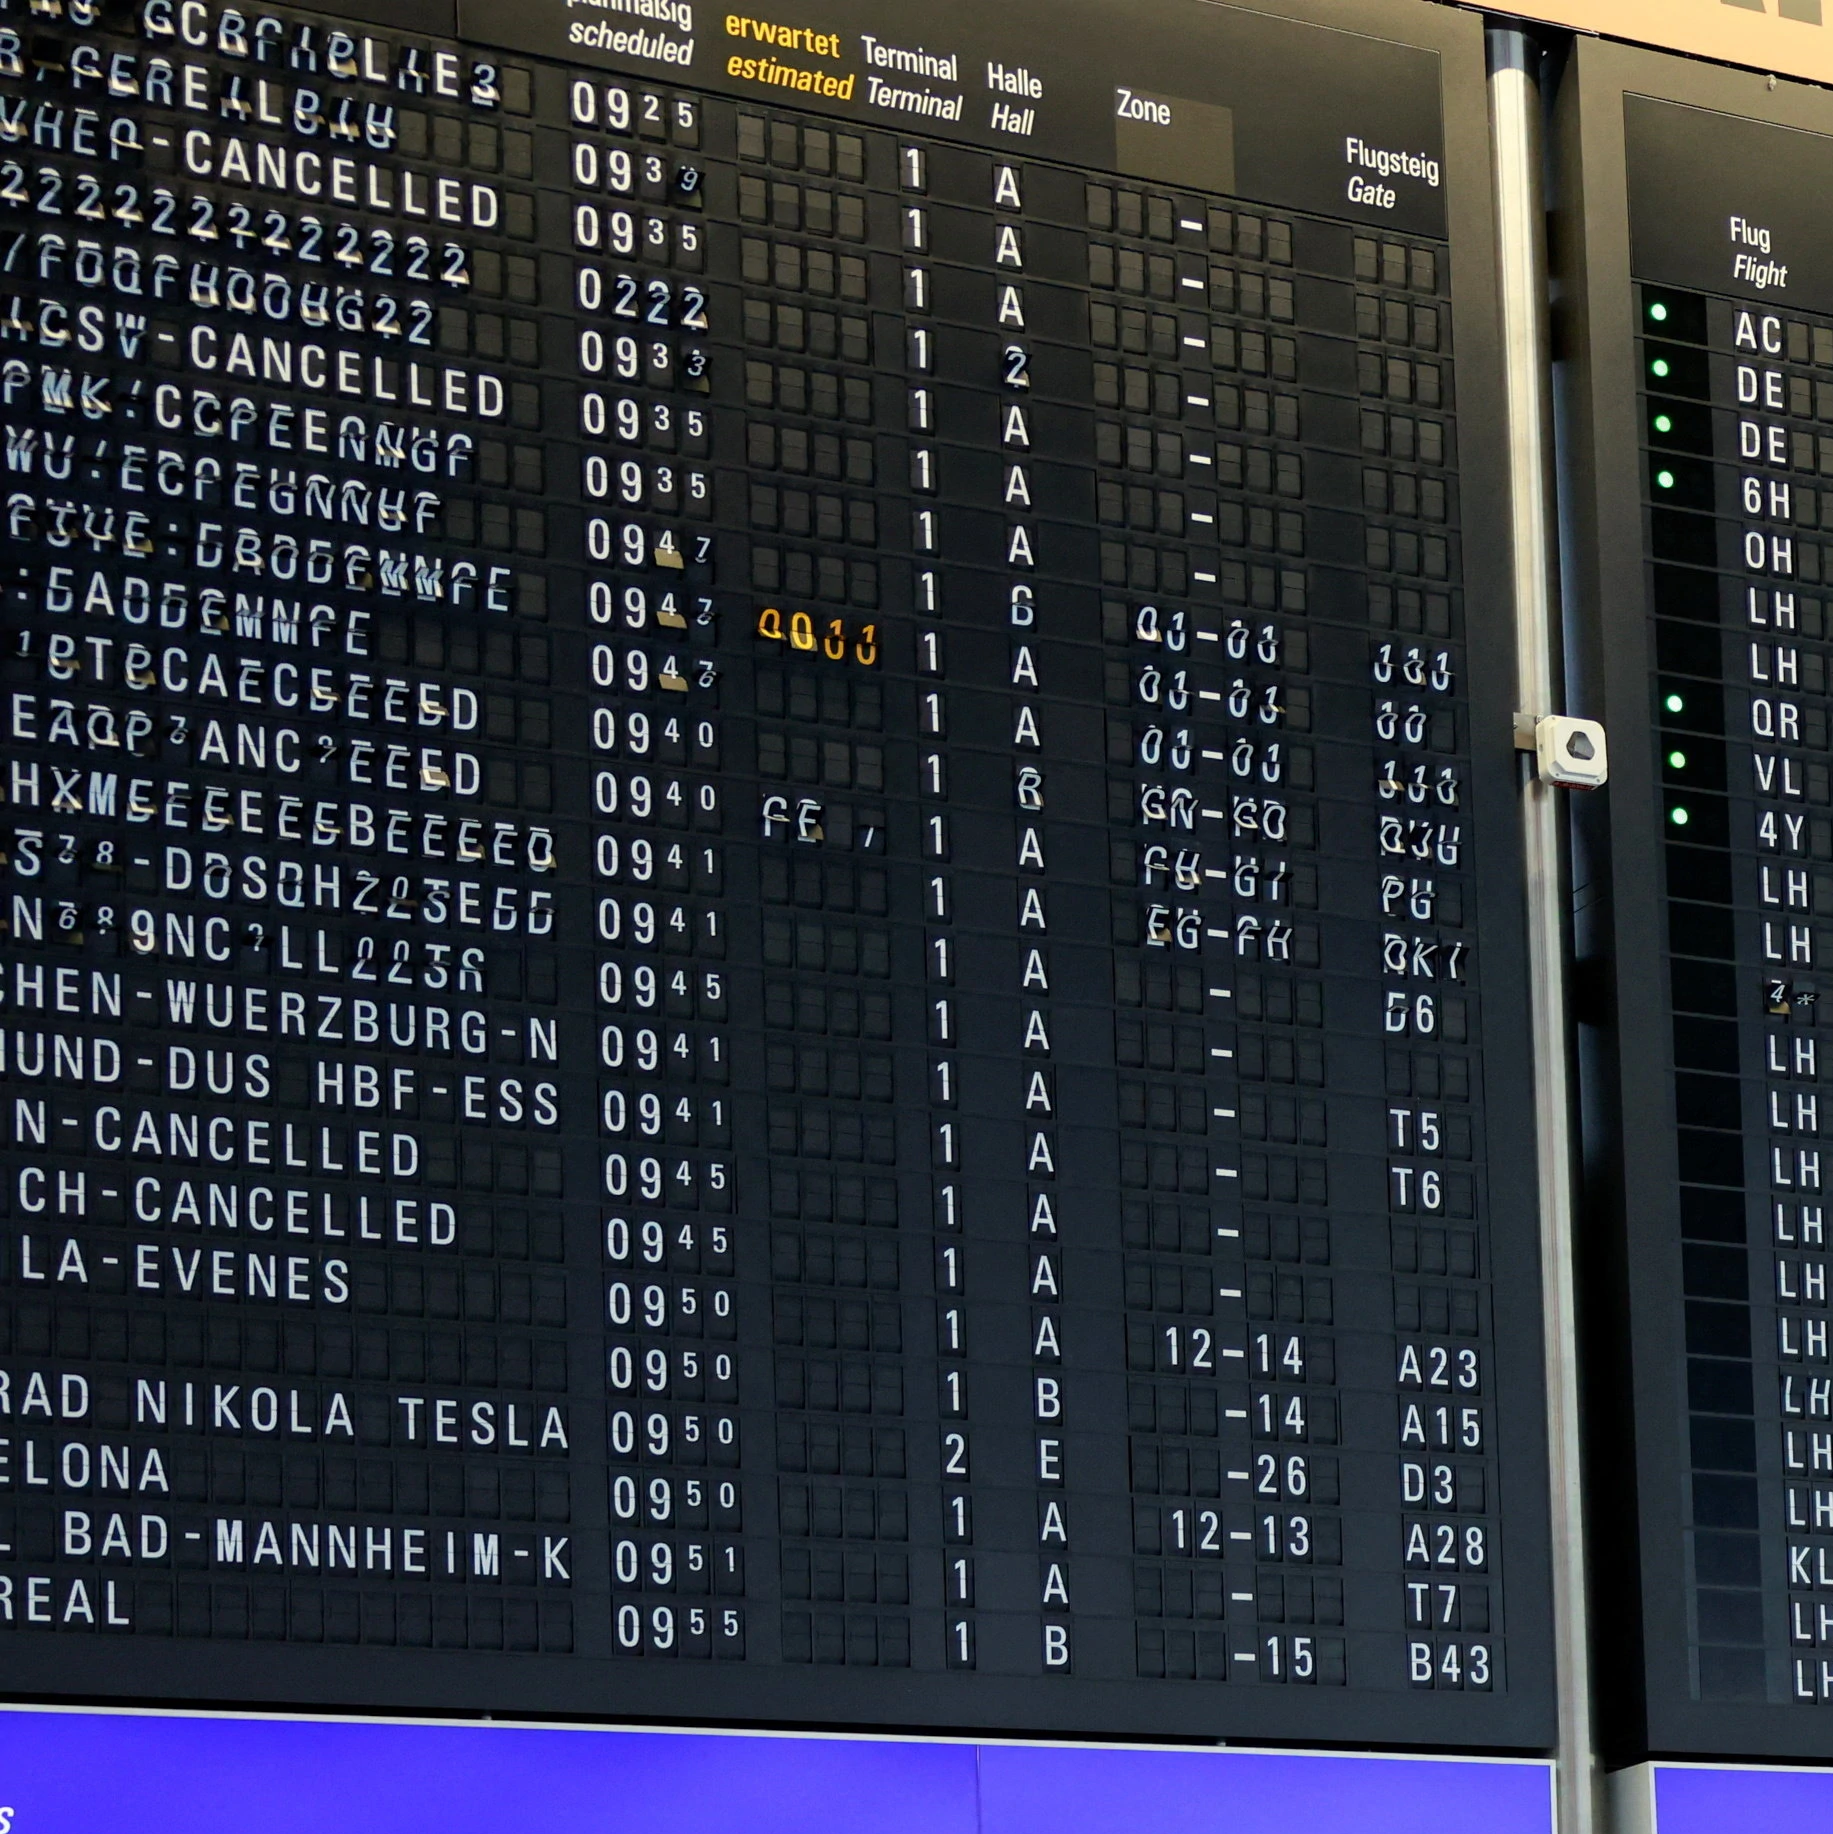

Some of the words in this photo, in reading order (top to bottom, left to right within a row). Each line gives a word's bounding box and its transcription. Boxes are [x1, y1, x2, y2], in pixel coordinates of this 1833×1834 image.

[570, 22, 694, 65] scheduled
[726, 9, 839, 58] erwartet
[728, 53, 854, 100] estimated
[861, 36, 957, 81] Terminal
[988, 62, 1042, 98] Halle
[868, 77, 963, 120] Terminal
[992, 103, 1034, 135] Hall
[1118, 89, 1170, 124] Zone
[1347, 138, 1438, 186] Flugsteig
[1348, 176, 1395, 208] Gate
[1731, 217, 1770, 253] Flug
[1734, 255, 1787, 288] Flight
[1736, 312, 1780, 353] AC
[319, 1062, 557, 1125] HBF-ESS
[1390, 1109, 1438, 1150] T5
[1167, 1327, 1302, 1374] 12-14
[1399, 1345, 1476, 1387] A23
[138, 1380, 353, 1435] NIKOLA
[399, 1398, 567, 1448] TESLA
[65, 1511, 569, 1578] BAD-MANNHEIM-K
[1411, 1643, 1488, 1683] B43
